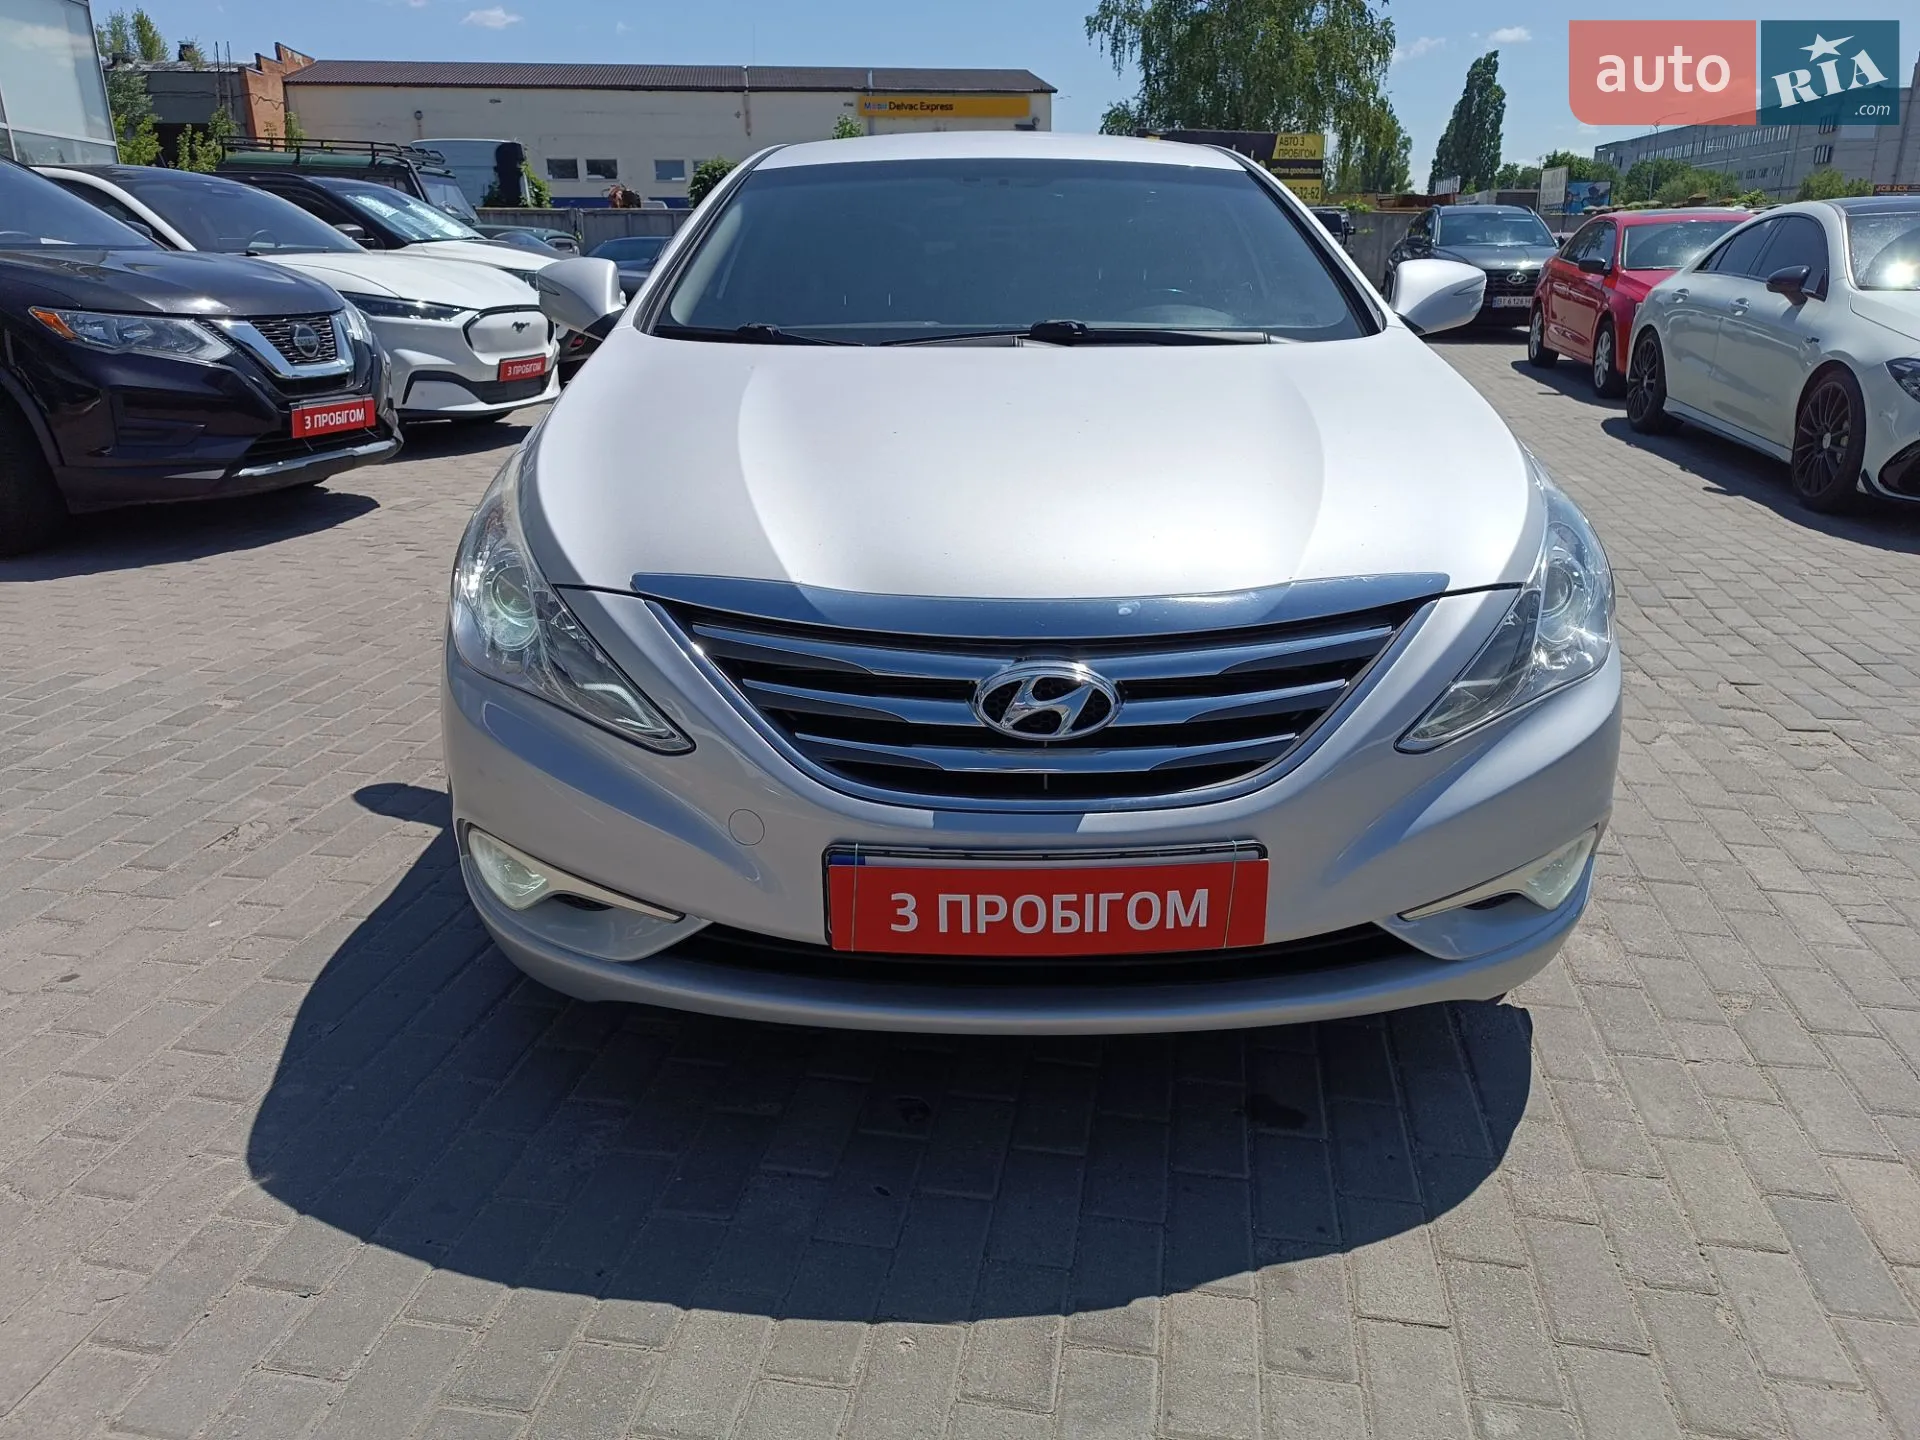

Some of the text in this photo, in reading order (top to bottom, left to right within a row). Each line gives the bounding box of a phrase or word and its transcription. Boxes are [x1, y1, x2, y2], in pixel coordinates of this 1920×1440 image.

[888, 101, 918, 111] Delvac
[919, 101, 954, 113] Express
[1279, 136, 1299, 147] АВТО
[1278, 148, 1317, 158] ПРОБІГОМ
[513, 362, 542, 375] ПРОБІГОМ
[314, 408, 365, 429] ПРОБІГОМ
[890, 888, 1209, 934] З ПРОБІГОМ
